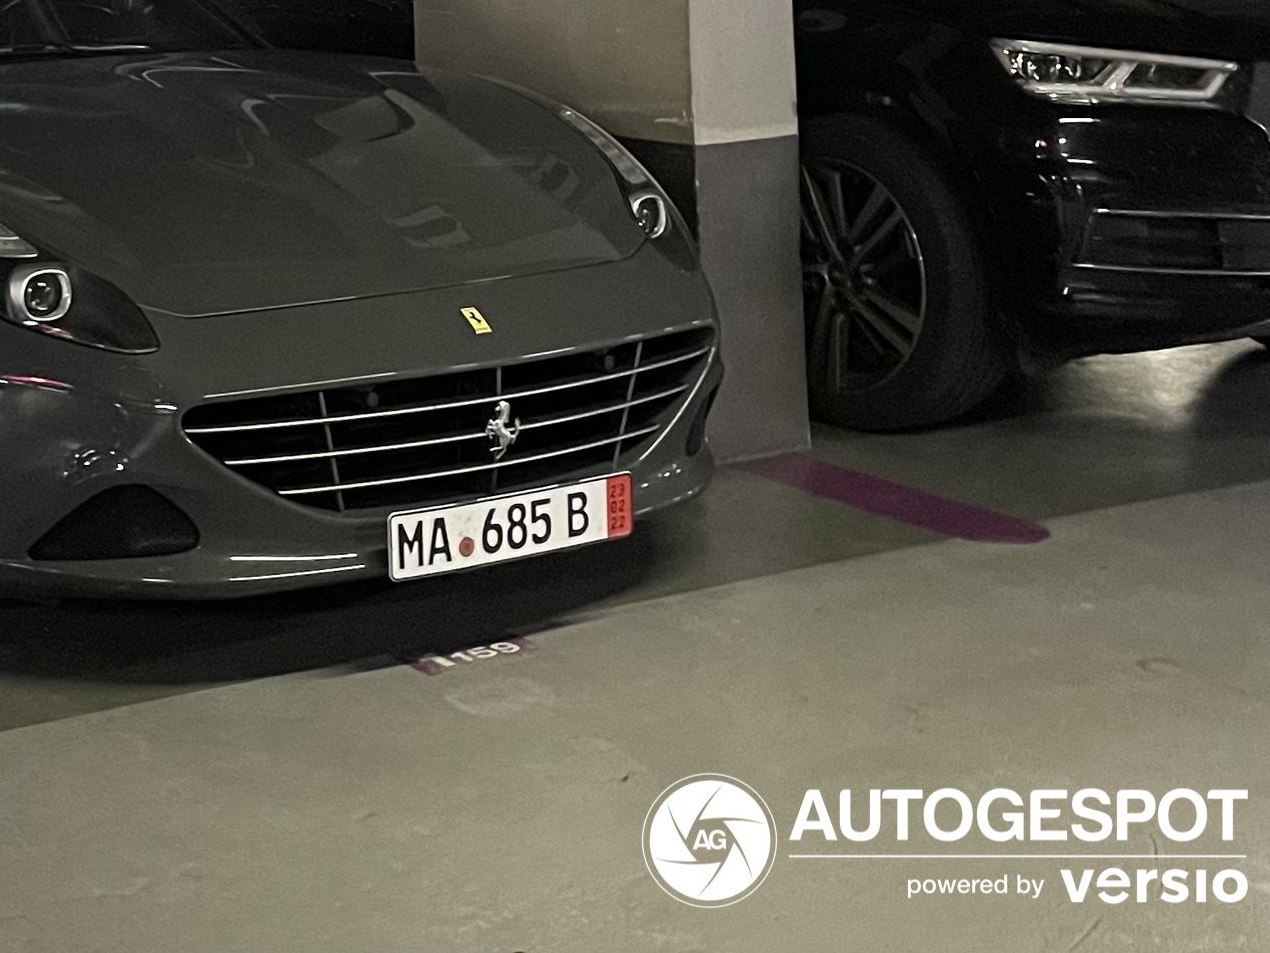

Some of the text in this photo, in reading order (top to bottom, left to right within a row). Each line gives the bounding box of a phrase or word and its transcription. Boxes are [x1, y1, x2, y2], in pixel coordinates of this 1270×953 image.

[610, 499, 625, 514] 02
[398, 491, 590, 570] MA 685 B
